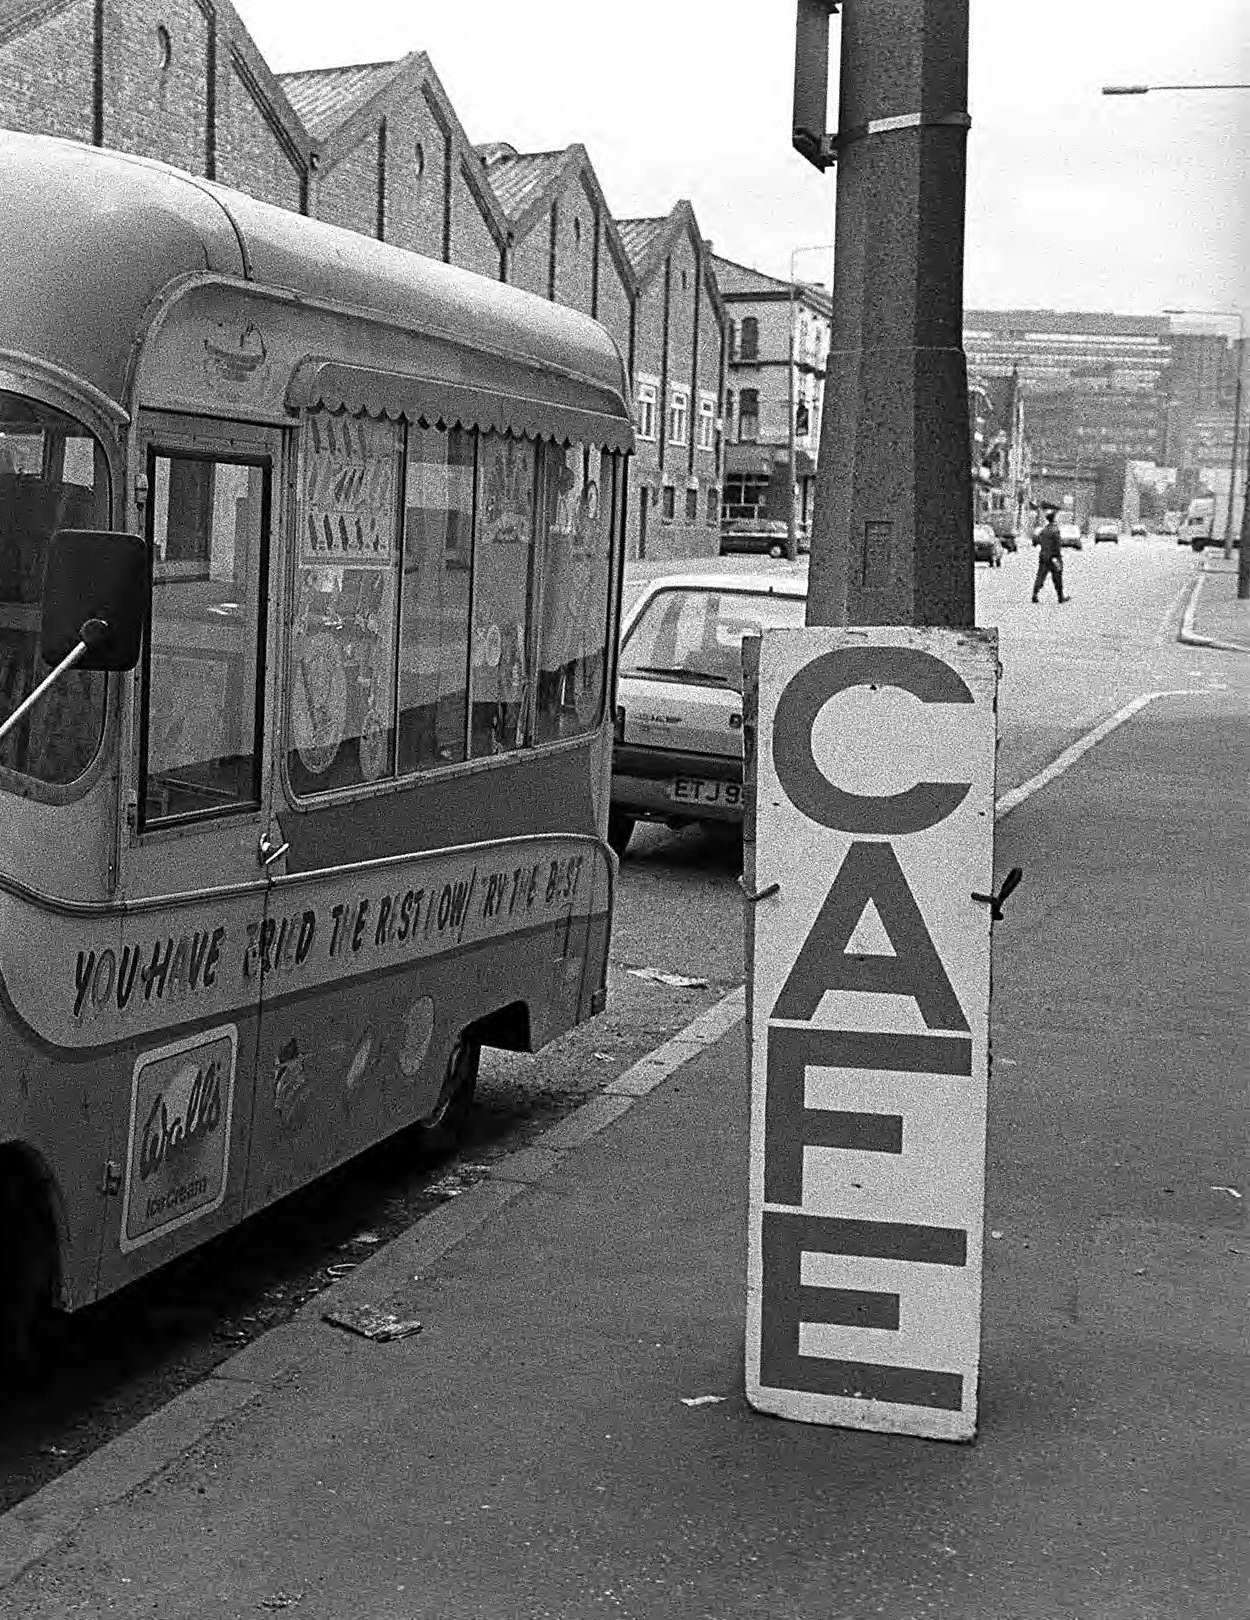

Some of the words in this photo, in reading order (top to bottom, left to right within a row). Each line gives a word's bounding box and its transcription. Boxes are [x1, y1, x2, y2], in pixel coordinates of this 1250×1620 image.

[674, 779, 720, 800] ETJ
[73, 945, 140, 1018] YOU
[142, 926, 225, 1000] HAVE
[760, 645, 974, 1412] CAFE
